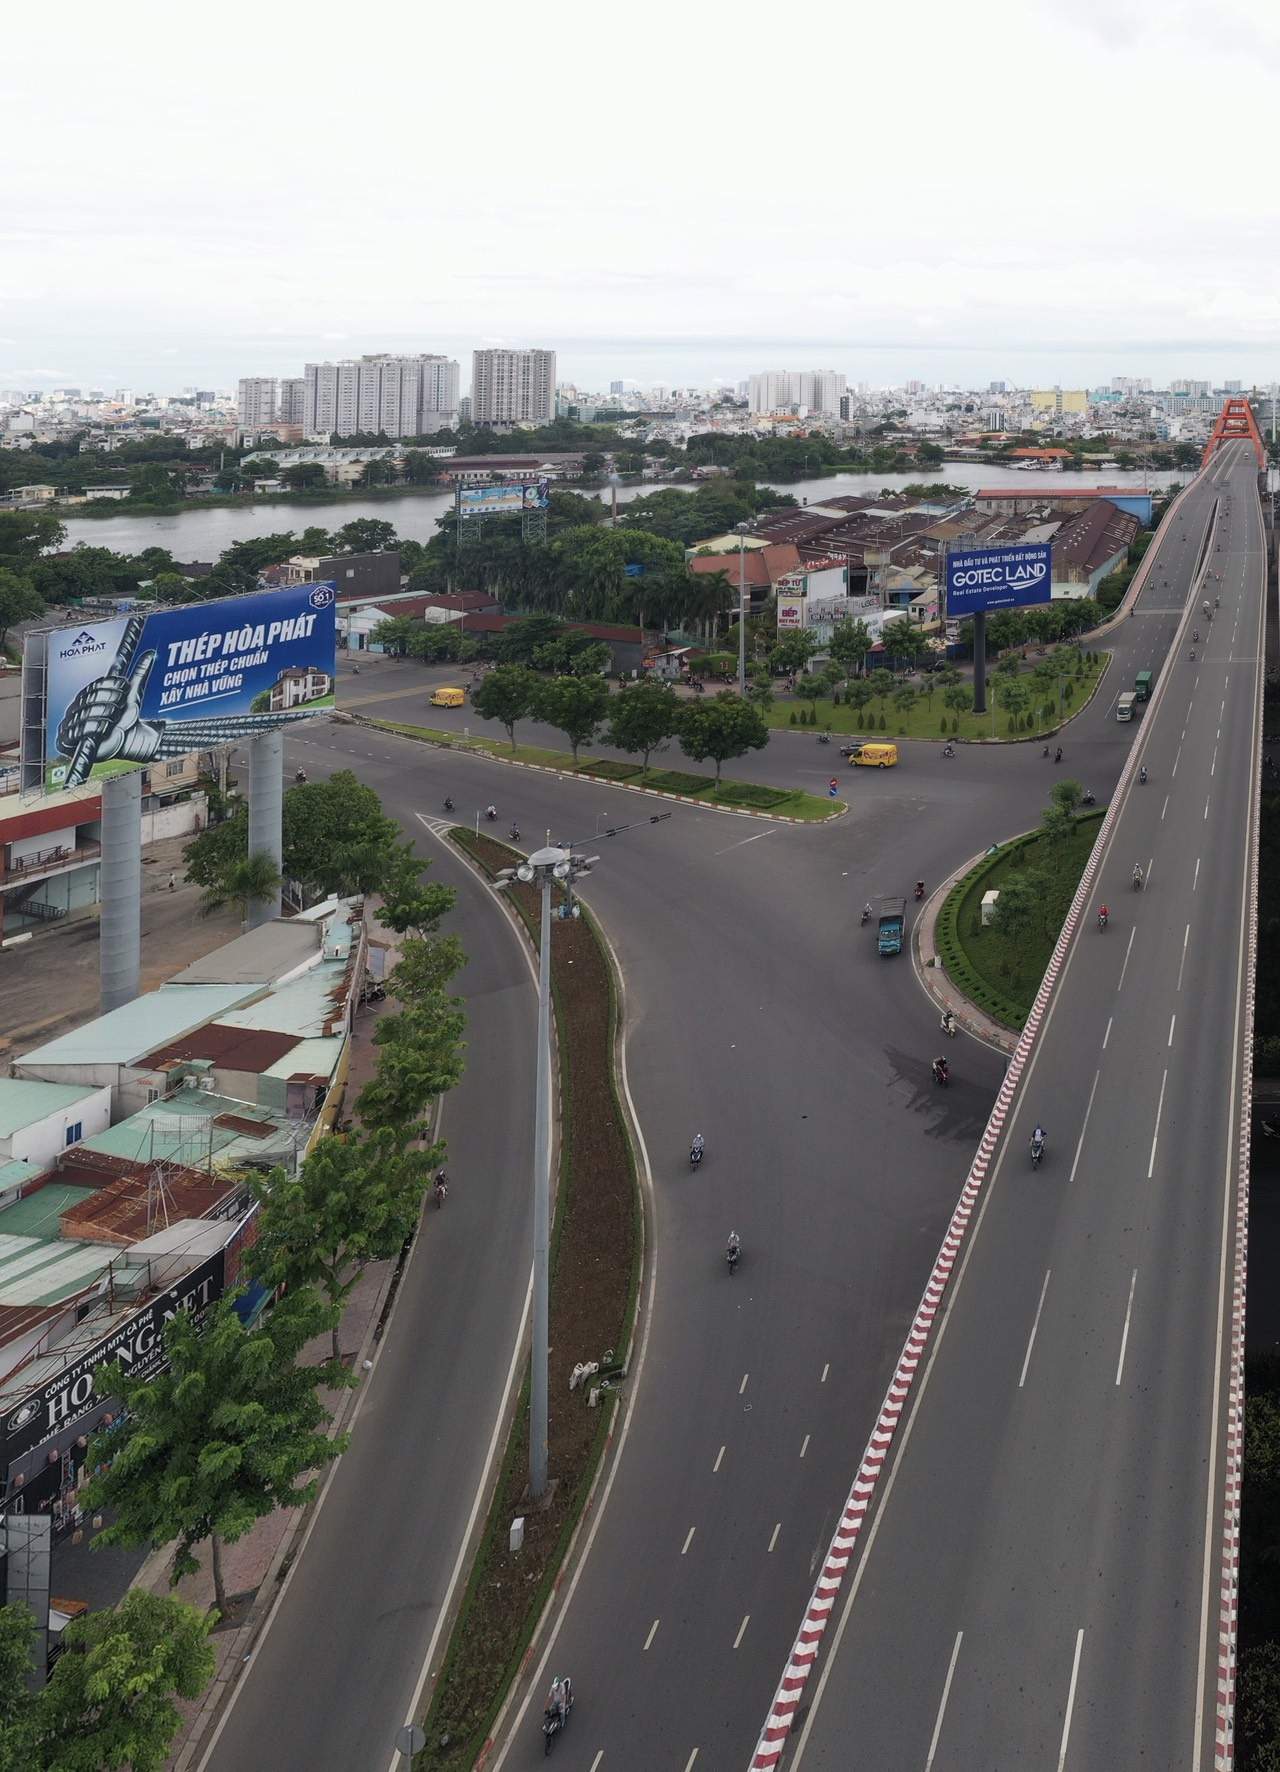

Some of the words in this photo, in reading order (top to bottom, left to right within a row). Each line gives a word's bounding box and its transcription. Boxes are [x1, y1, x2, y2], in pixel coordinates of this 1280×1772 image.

[953, 568, 1003, 587] GOTEC
[1006, 563, 1046, 580] LAND
[965, 587, 982, 595] Estate
[982, 585, 1008, 593] Developer
[167, 631, 222, 667] THÉP
[221, 623, 265, 655] HÒA
[266, 612, 317, 645] PHÁT
[163, 666, 198, 687] CHỌN
[200, 658, 228, 679] THÉP
[229, 647, 269, 670] CHUẨN
[720, 661, 729, 670] 13
[160, 686, 185, 706] XÂY
[184, 679, 209, 699] NHÀ
[212, 674, 243, 693] VỮNG
[45, 1375, 70, 1399] CÔNG
[71, 1365, 82, 1379] TY
[83, 1348, 106, 1369] TNHH
[107, 1331, 125, 1351] MTV
[126, 1322, 138, 1336] CÀ
[138, 1308, 153, 1327] PHÊ
